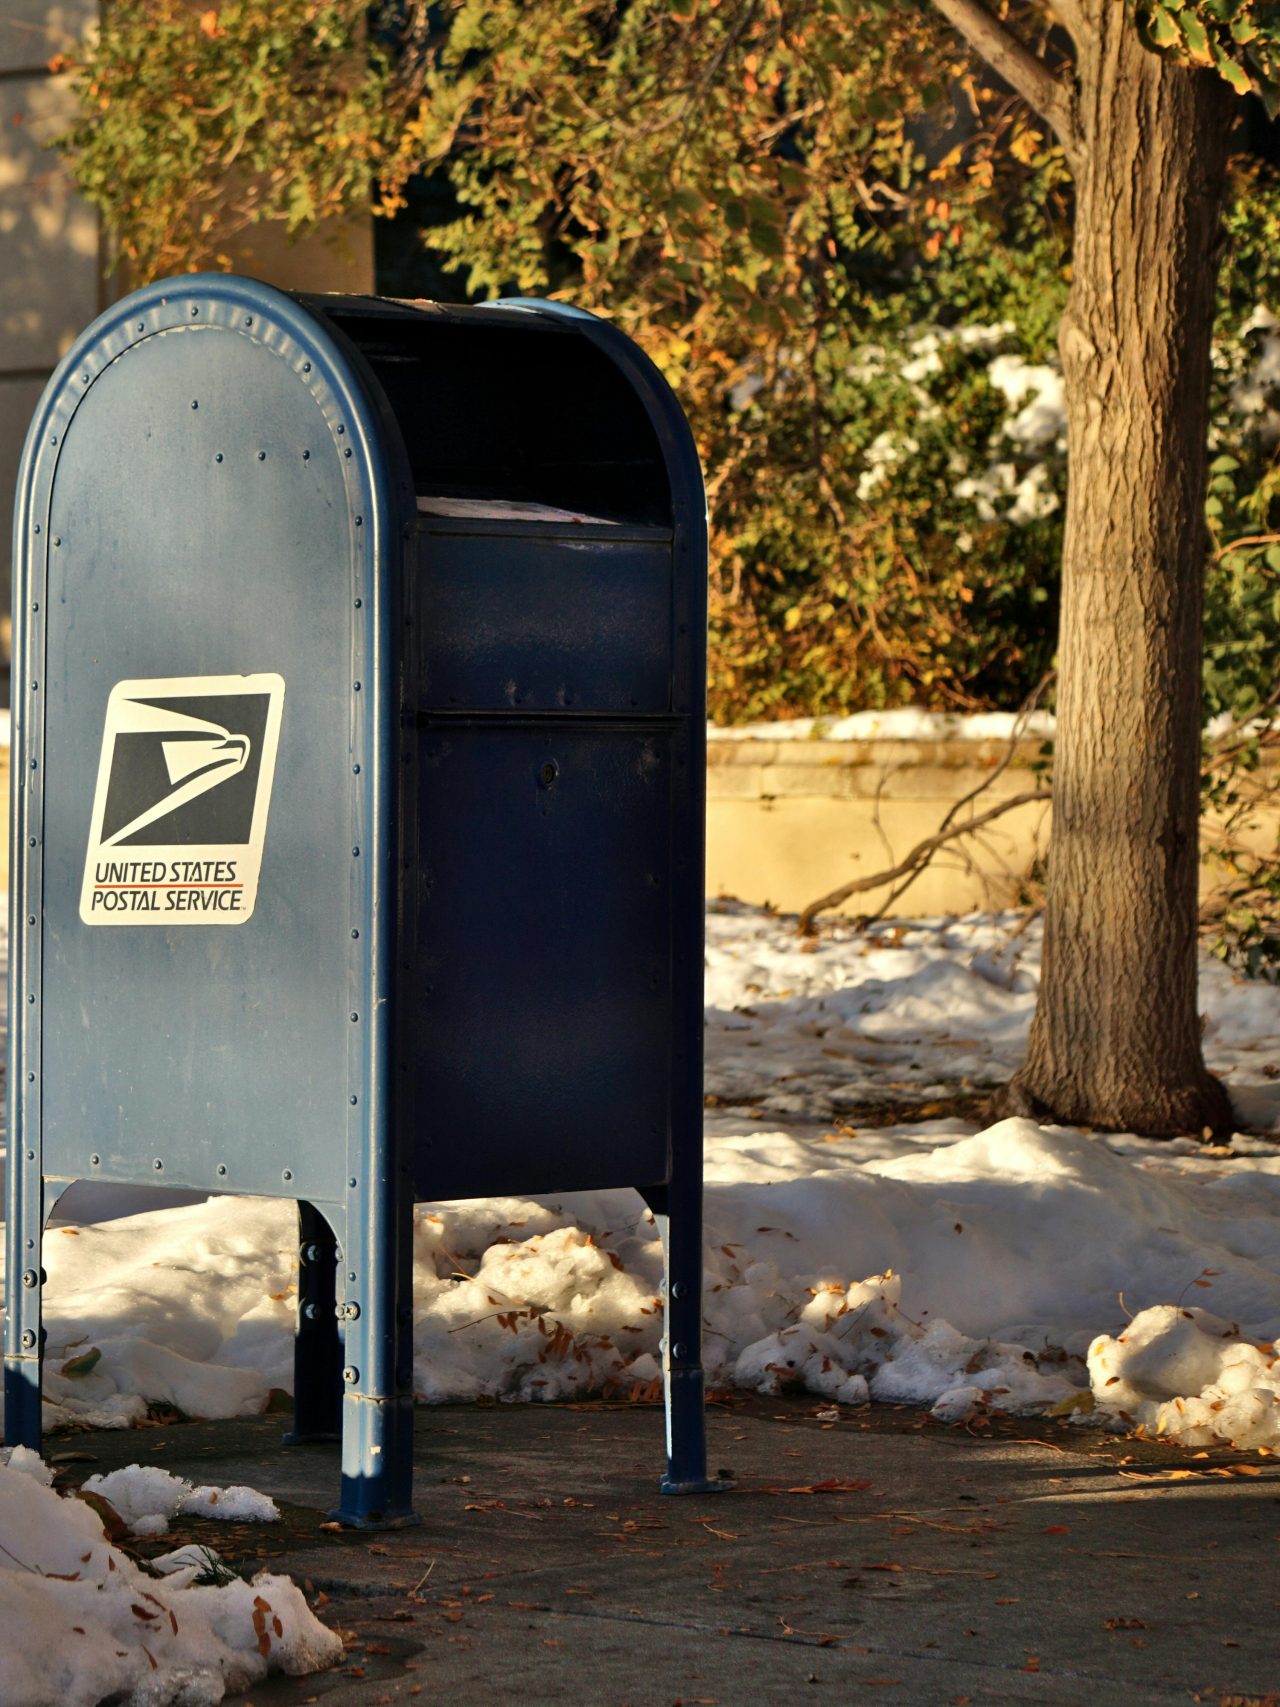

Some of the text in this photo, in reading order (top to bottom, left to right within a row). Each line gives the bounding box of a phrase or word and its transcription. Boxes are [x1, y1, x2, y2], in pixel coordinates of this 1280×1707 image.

[95, 861, 237, 883] UNITED STATES
[91, 890, 243, 911] POSTAL SERVICE
